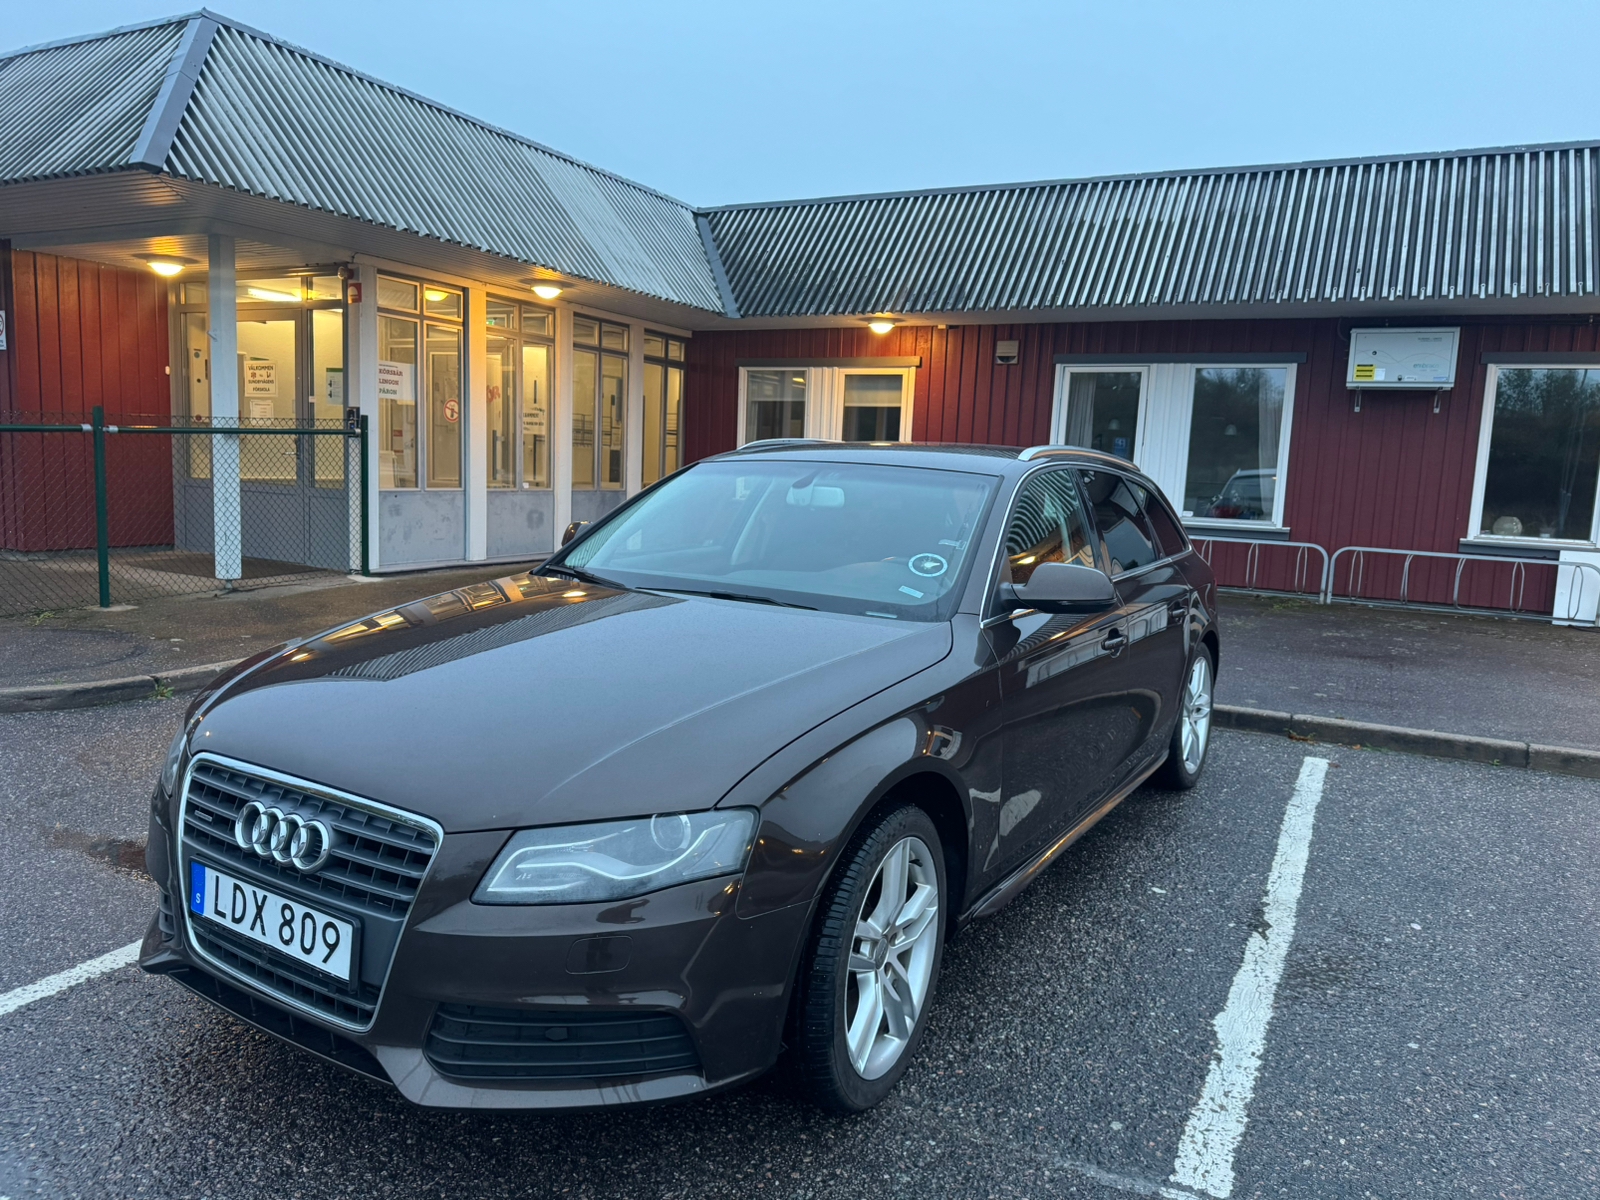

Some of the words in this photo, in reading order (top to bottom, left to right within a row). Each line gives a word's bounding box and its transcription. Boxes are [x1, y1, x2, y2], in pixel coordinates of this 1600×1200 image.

[195, 892, 202, 904] S
[213, 875, 268, 937] LDX
[278, 903, 341, 964] 809
